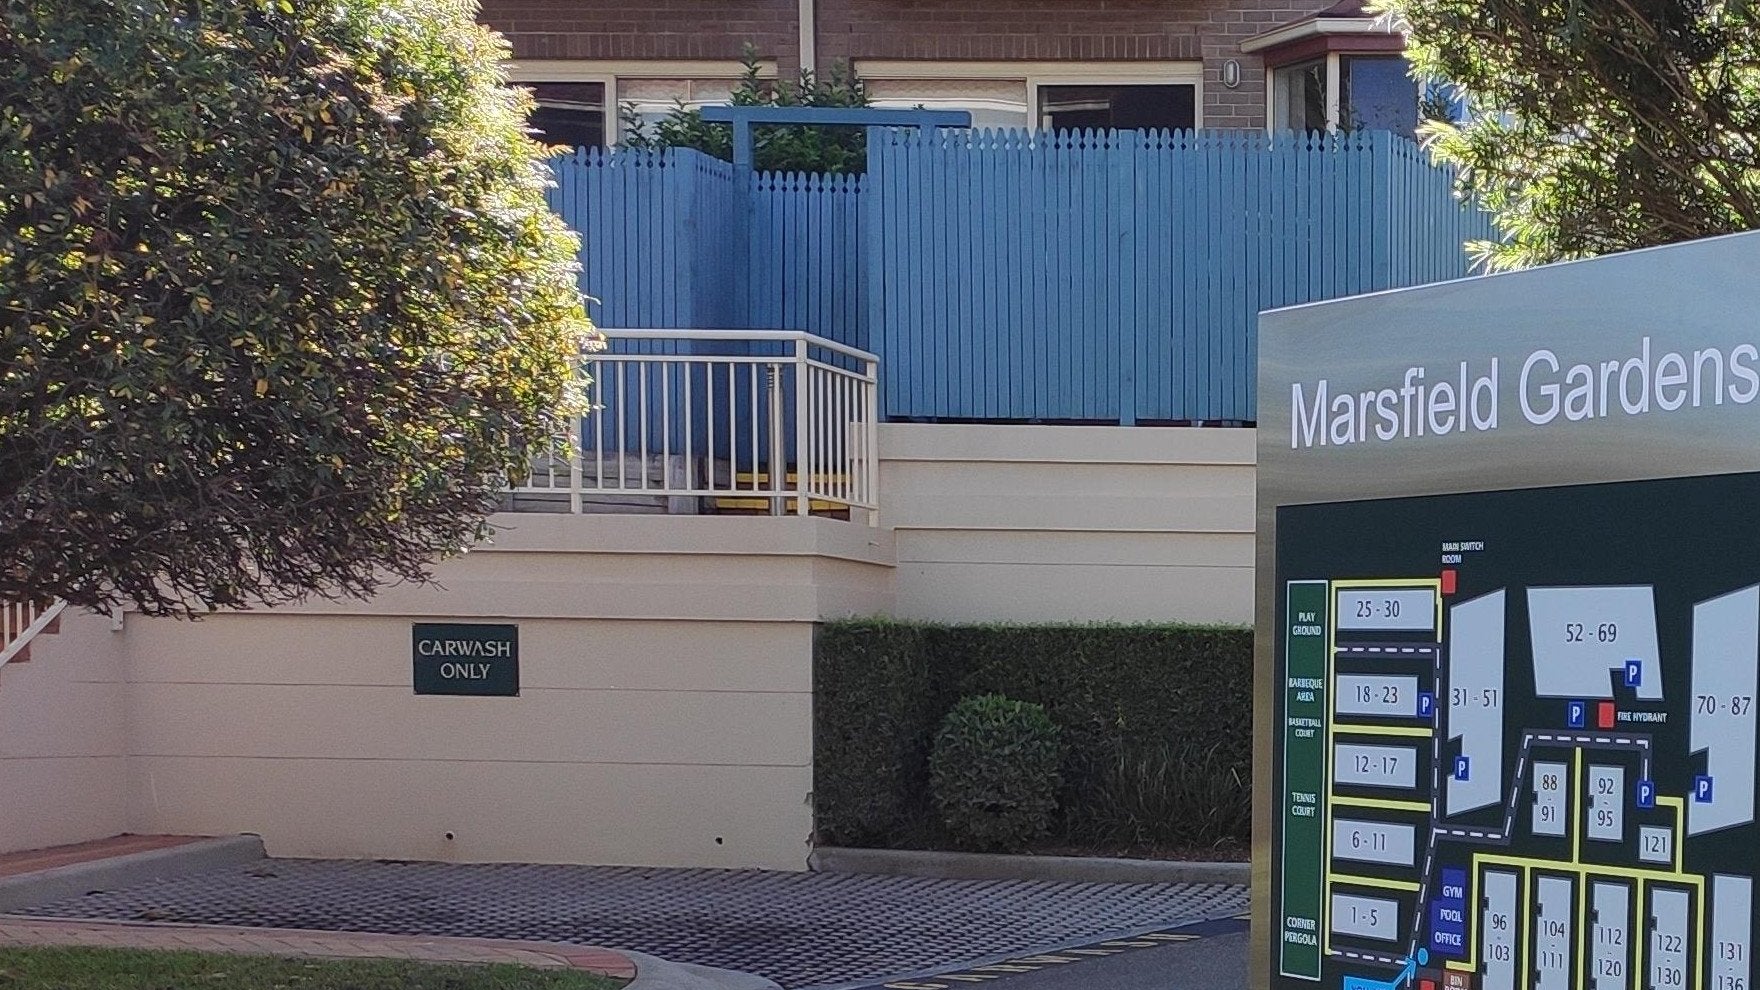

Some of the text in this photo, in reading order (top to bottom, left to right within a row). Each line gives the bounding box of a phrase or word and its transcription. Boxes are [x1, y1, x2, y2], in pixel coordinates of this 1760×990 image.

[1291, 337, 1760, 449] Marsfield Gardens
[1442, 541, 1484, 552] MAIN SWITCH
[1441, 554, 1462, 564] ROOM
[1298, 612, 1315, 622] PLAY
[1357, 601, 1371, 617] 25
[1384, 600, 1400, 617] 30
[1292, 625, 1321, 636] GROUND
[1566, 624, 1583, 642] 52
[1598, 623, 1617, 643] 69
[418, 640, 510, 657] CARWASH
[440, 662, 491, 679] ONLY
[1629, 665, 1637, 683] P
[1289, 677, 1323, 689] BARBEQUE
[1296, 692, 1315, 702] AREA
[1357, 685, 1371, 703] 18
[1383, 686, 1398, 704] 23
[1453, 688, 1467, 706] 31
[1483, 689, 1497, 707] 51
[1422, 698, 1429, 712] P
[1697, 696, 1716, 714] 70
[1731, 696, 1752, 716] 87
[1289, 717, 1321, 728] BASKETBALL
[1572, 706, 1581, 723] P
[1617, 711, 1667, 723] FIRE HYDRANT
[1295, 729, 1315, 738] COURT
[1355, 755, 1369, 773] 12
[1383, 757, 1398, 774] 17
[1458, 760, 1466, 777] P
[1542, 774, 1558, 791] 88
[1598, 778, 1614, 795] 92
[1699, 781, 1709, 798] P
[1292, 792, 1316, 804] TENNIS
[1641, 786, 1650, 803] P
[1292, 805, 1315, 817] COURT
[1541, 806, 1556, 822] 91
[1597, 810, 1613, 827] 95
[1352, 831, 1359, 848] 6
[1373, 833, 1386, 851] 11
[1644, 836, 1667, 854] 121
[1443, 885, 1462, 899] GYM
[1287, 916, 1316, 930] CORNER
[1351, 907, 1357, 923] 1
[1370, 909, 1378, 926] 5
[1440, 909, 1463, 922] POOL
[1492, 914, 1507, 930] 96
[1543, 920, 1565, 938] 104
[1600, 928, 1622, 946] 112
[1284, 931, 1318, 946] PERGOLA
[1435, 931, 1462, 946] OFFICE
[1657, 935, 1682, 953] 122
[1489, 944, 1510, 962] 103
[1719, 942, 1743, 961] 131
[1542, 951, 1563, 970] 111
[1598, 959, 1622, 978] 120
[1450, 975, 1463, 986] BIN
[1657, 967, 1682, 986] 130
